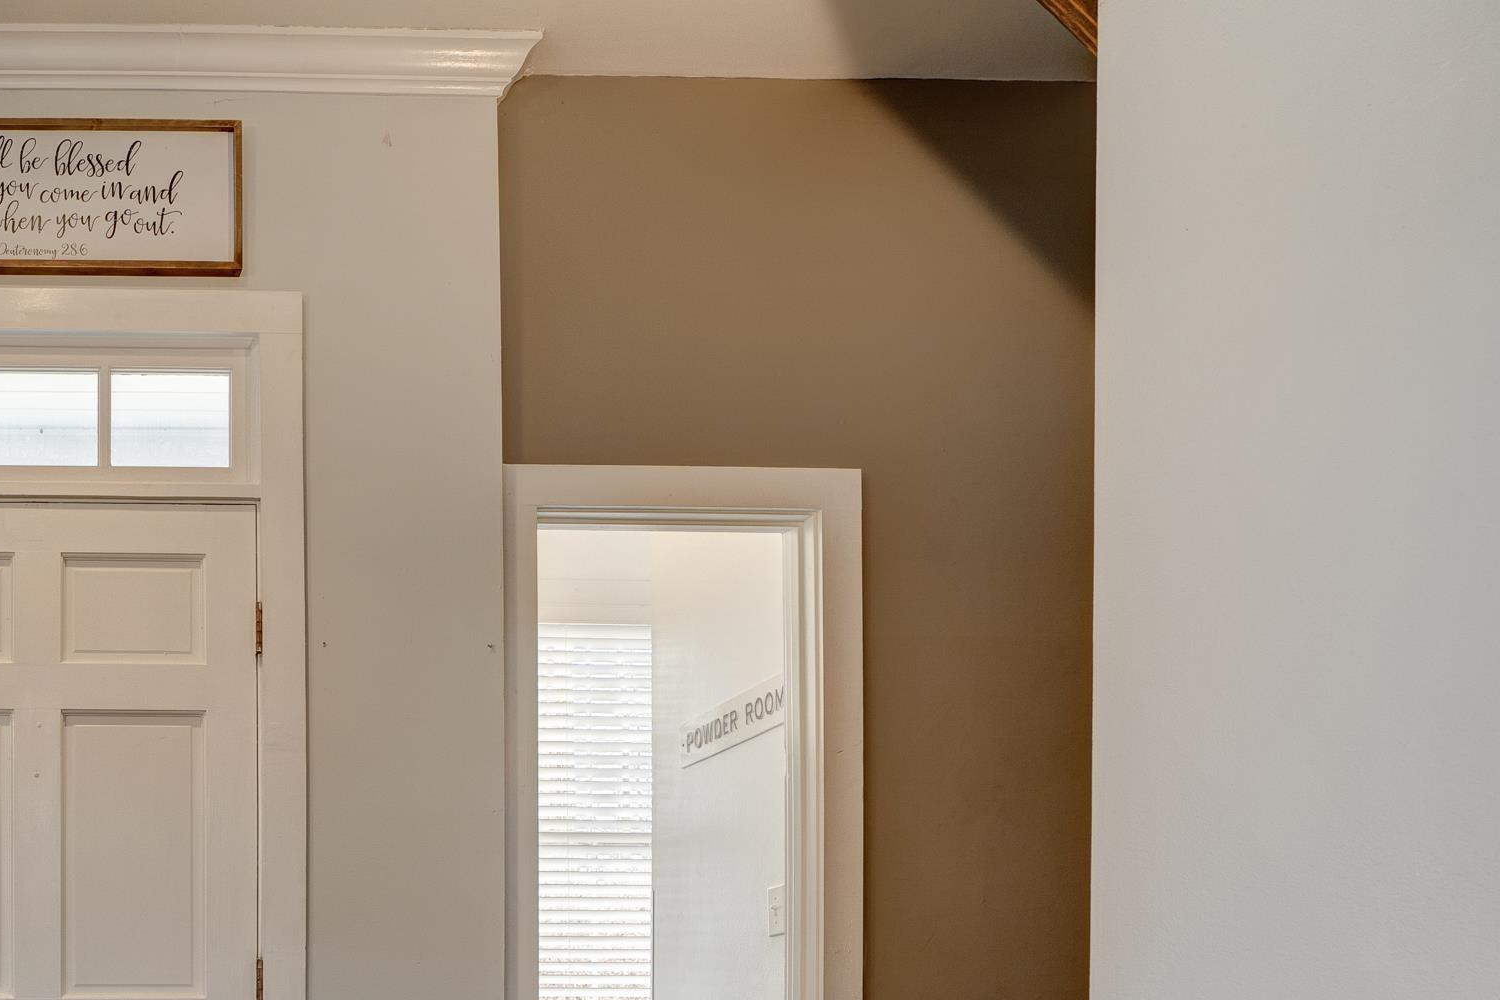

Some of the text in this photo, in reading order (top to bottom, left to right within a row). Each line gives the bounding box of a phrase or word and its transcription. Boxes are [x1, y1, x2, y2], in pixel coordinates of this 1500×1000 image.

[20, 137, 49, 173] be
[55, 139, 142, 177] blessed
[40, 187, 98, 203] come
[101, 181, 132, 200] in
[129, 170, 183, 204] and
[56, 212, 100, 238] you
[104, 208, 139, 239] go
[133, 207, 183, 236] out.
[686, 709, 738, 753] POWDER
